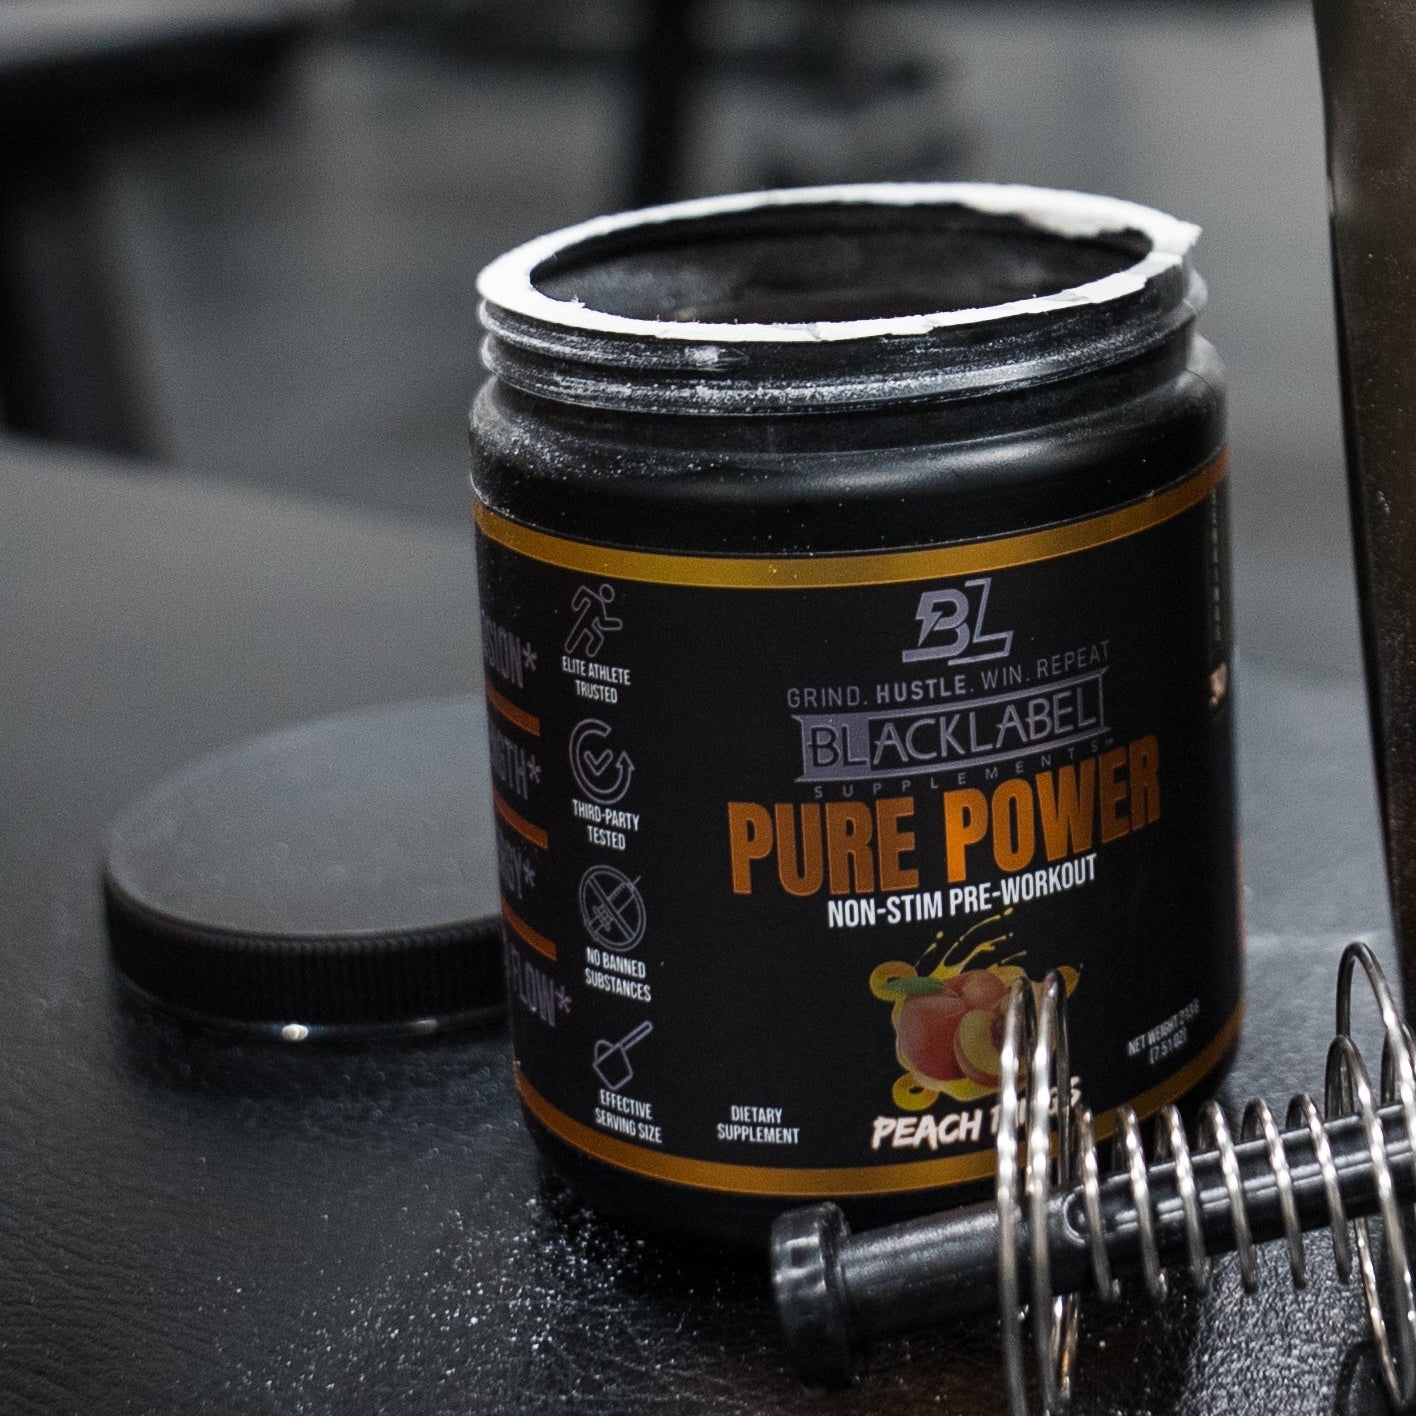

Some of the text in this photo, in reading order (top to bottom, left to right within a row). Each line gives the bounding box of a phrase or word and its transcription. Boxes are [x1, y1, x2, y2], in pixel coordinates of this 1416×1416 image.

[902, 577, 1014, 666] BL
[562, 656, 631, 685] ELITE ATHLETE
[787, 640, 1111, 709] GRIND. HUSTLE. WIN. REPEAT
[575, 679, 618, 704] TRUSTED
[572, 799, 640, 831] THIRD-PARTY
[728, 733, 1162, 897] PURE POWER
[586, 825, 626, 851] TESTED
[827, 853, 1098, 928] NON-STIM PRE-WORKOUT
[586, 947, 646, 979] NO BANNED
[585, 967, 651, 1003] SUBSTANCES
[1128, 1034, 1146, 1056] NET
[599, 1089, 652, 1120] EFFECTIVE
[731, 1105, 782, 1124] DIETARY
[595, 1107, 662, 1144] SERVING SIZE
[717, 1123, 800, 1144] SUPPLEMENT
[871, 1108, 983, 1151] PEACH
